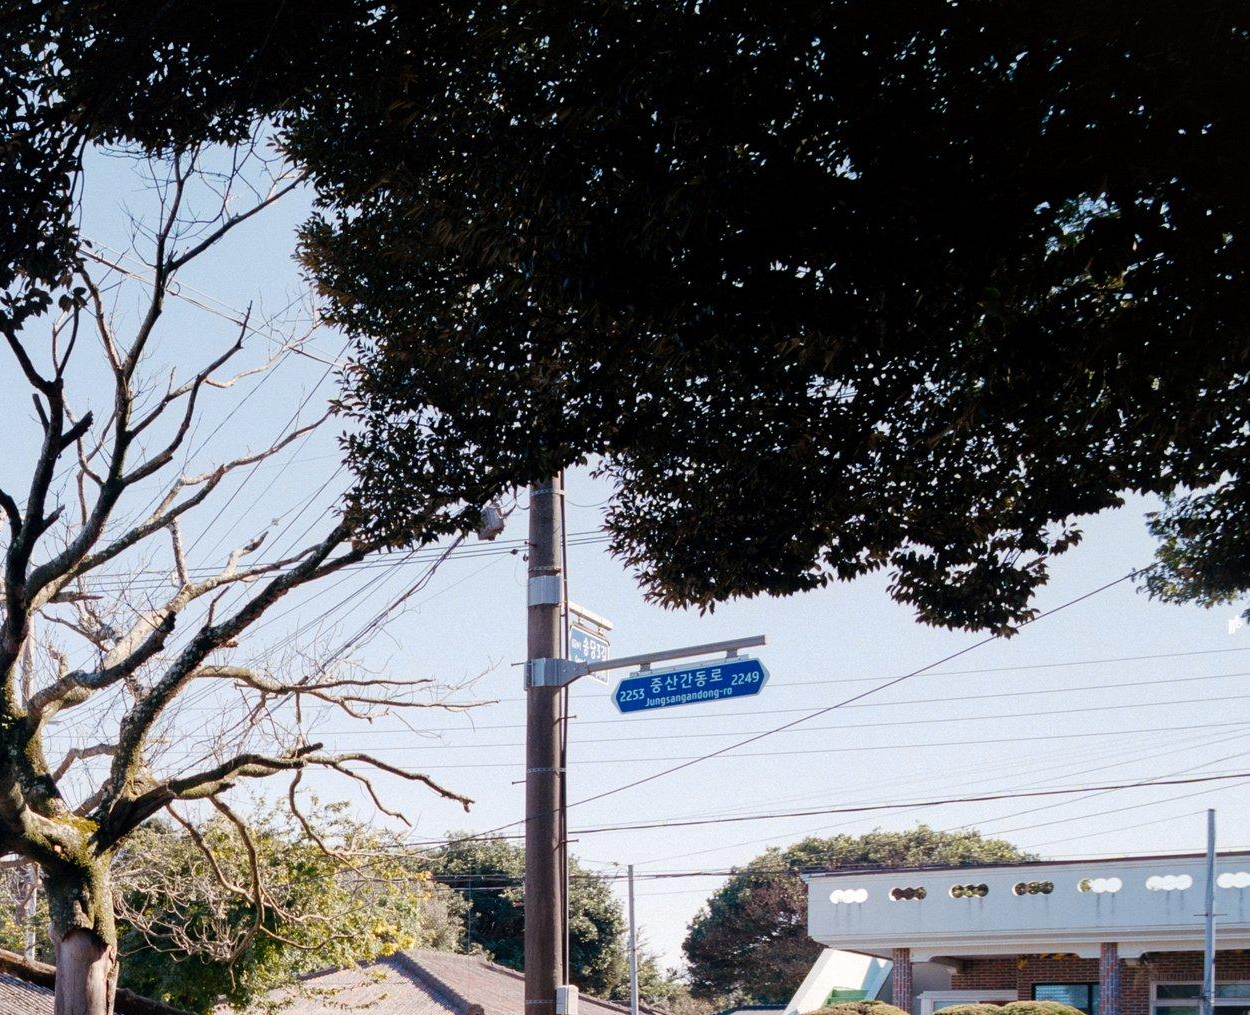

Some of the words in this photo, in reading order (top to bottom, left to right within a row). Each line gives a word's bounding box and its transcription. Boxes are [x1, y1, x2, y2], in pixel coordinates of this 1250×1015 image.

[650, 669, 723, 693] 중산간동로
[731, 671, 760, 686] 2249
[620, 688, 645, 702] 2253
[645, 687, 733, 706] Jungsangandong-ro
